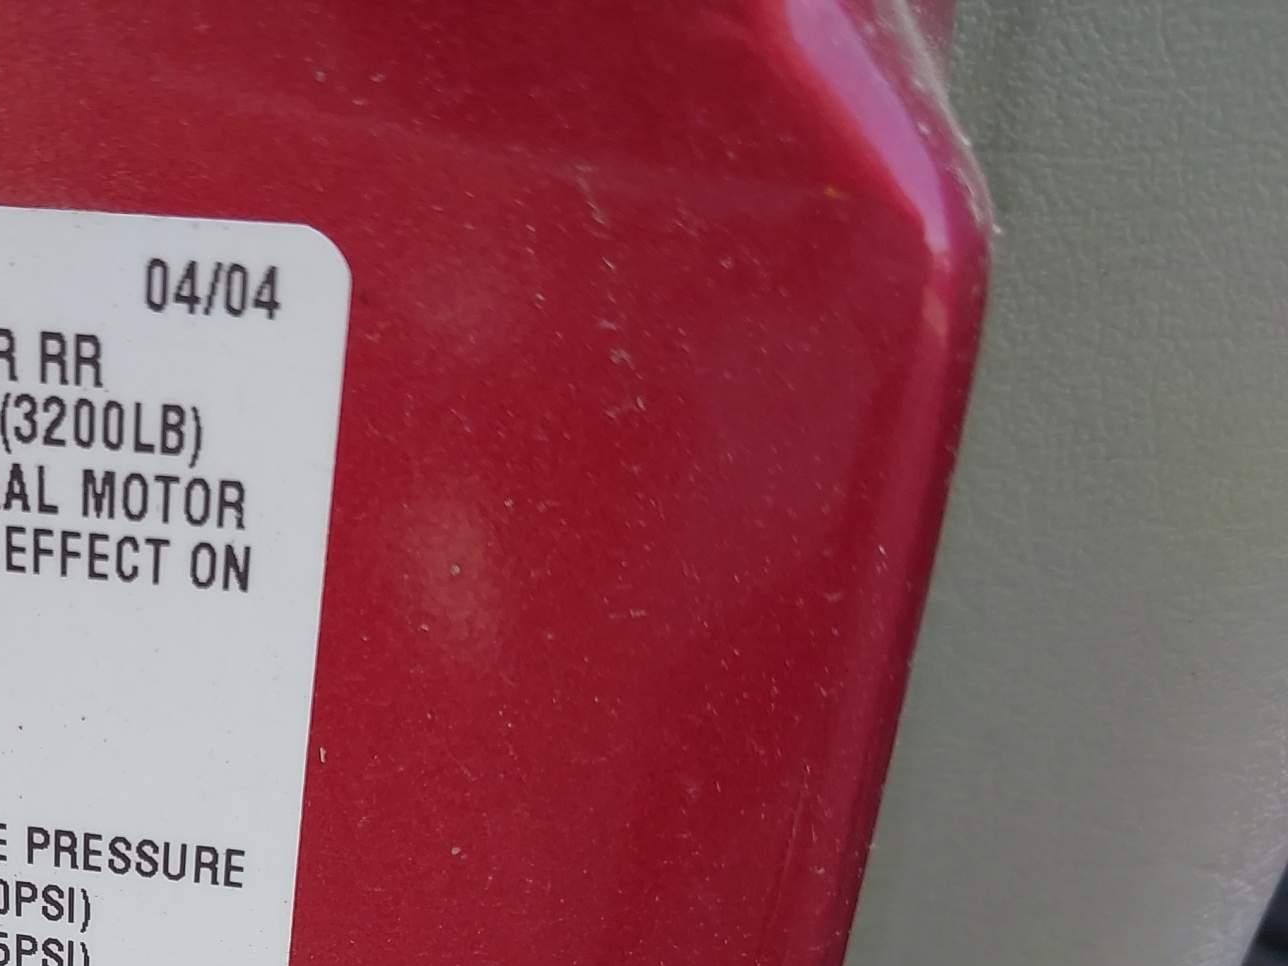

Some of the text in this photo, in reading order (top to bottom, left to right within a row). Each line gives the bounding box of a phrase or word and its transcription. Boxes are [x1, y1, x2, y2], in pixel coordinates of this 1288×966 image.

[144, 257, 281, 320] 04/04
[39, 329, 103, 388] RR
[81, 468, 245, 530] MOTOR
[4, 524, 171, 585] EFFECT
[189, 540, 251, 593] ON
[26, 825, 245, 888] PRESSURE
